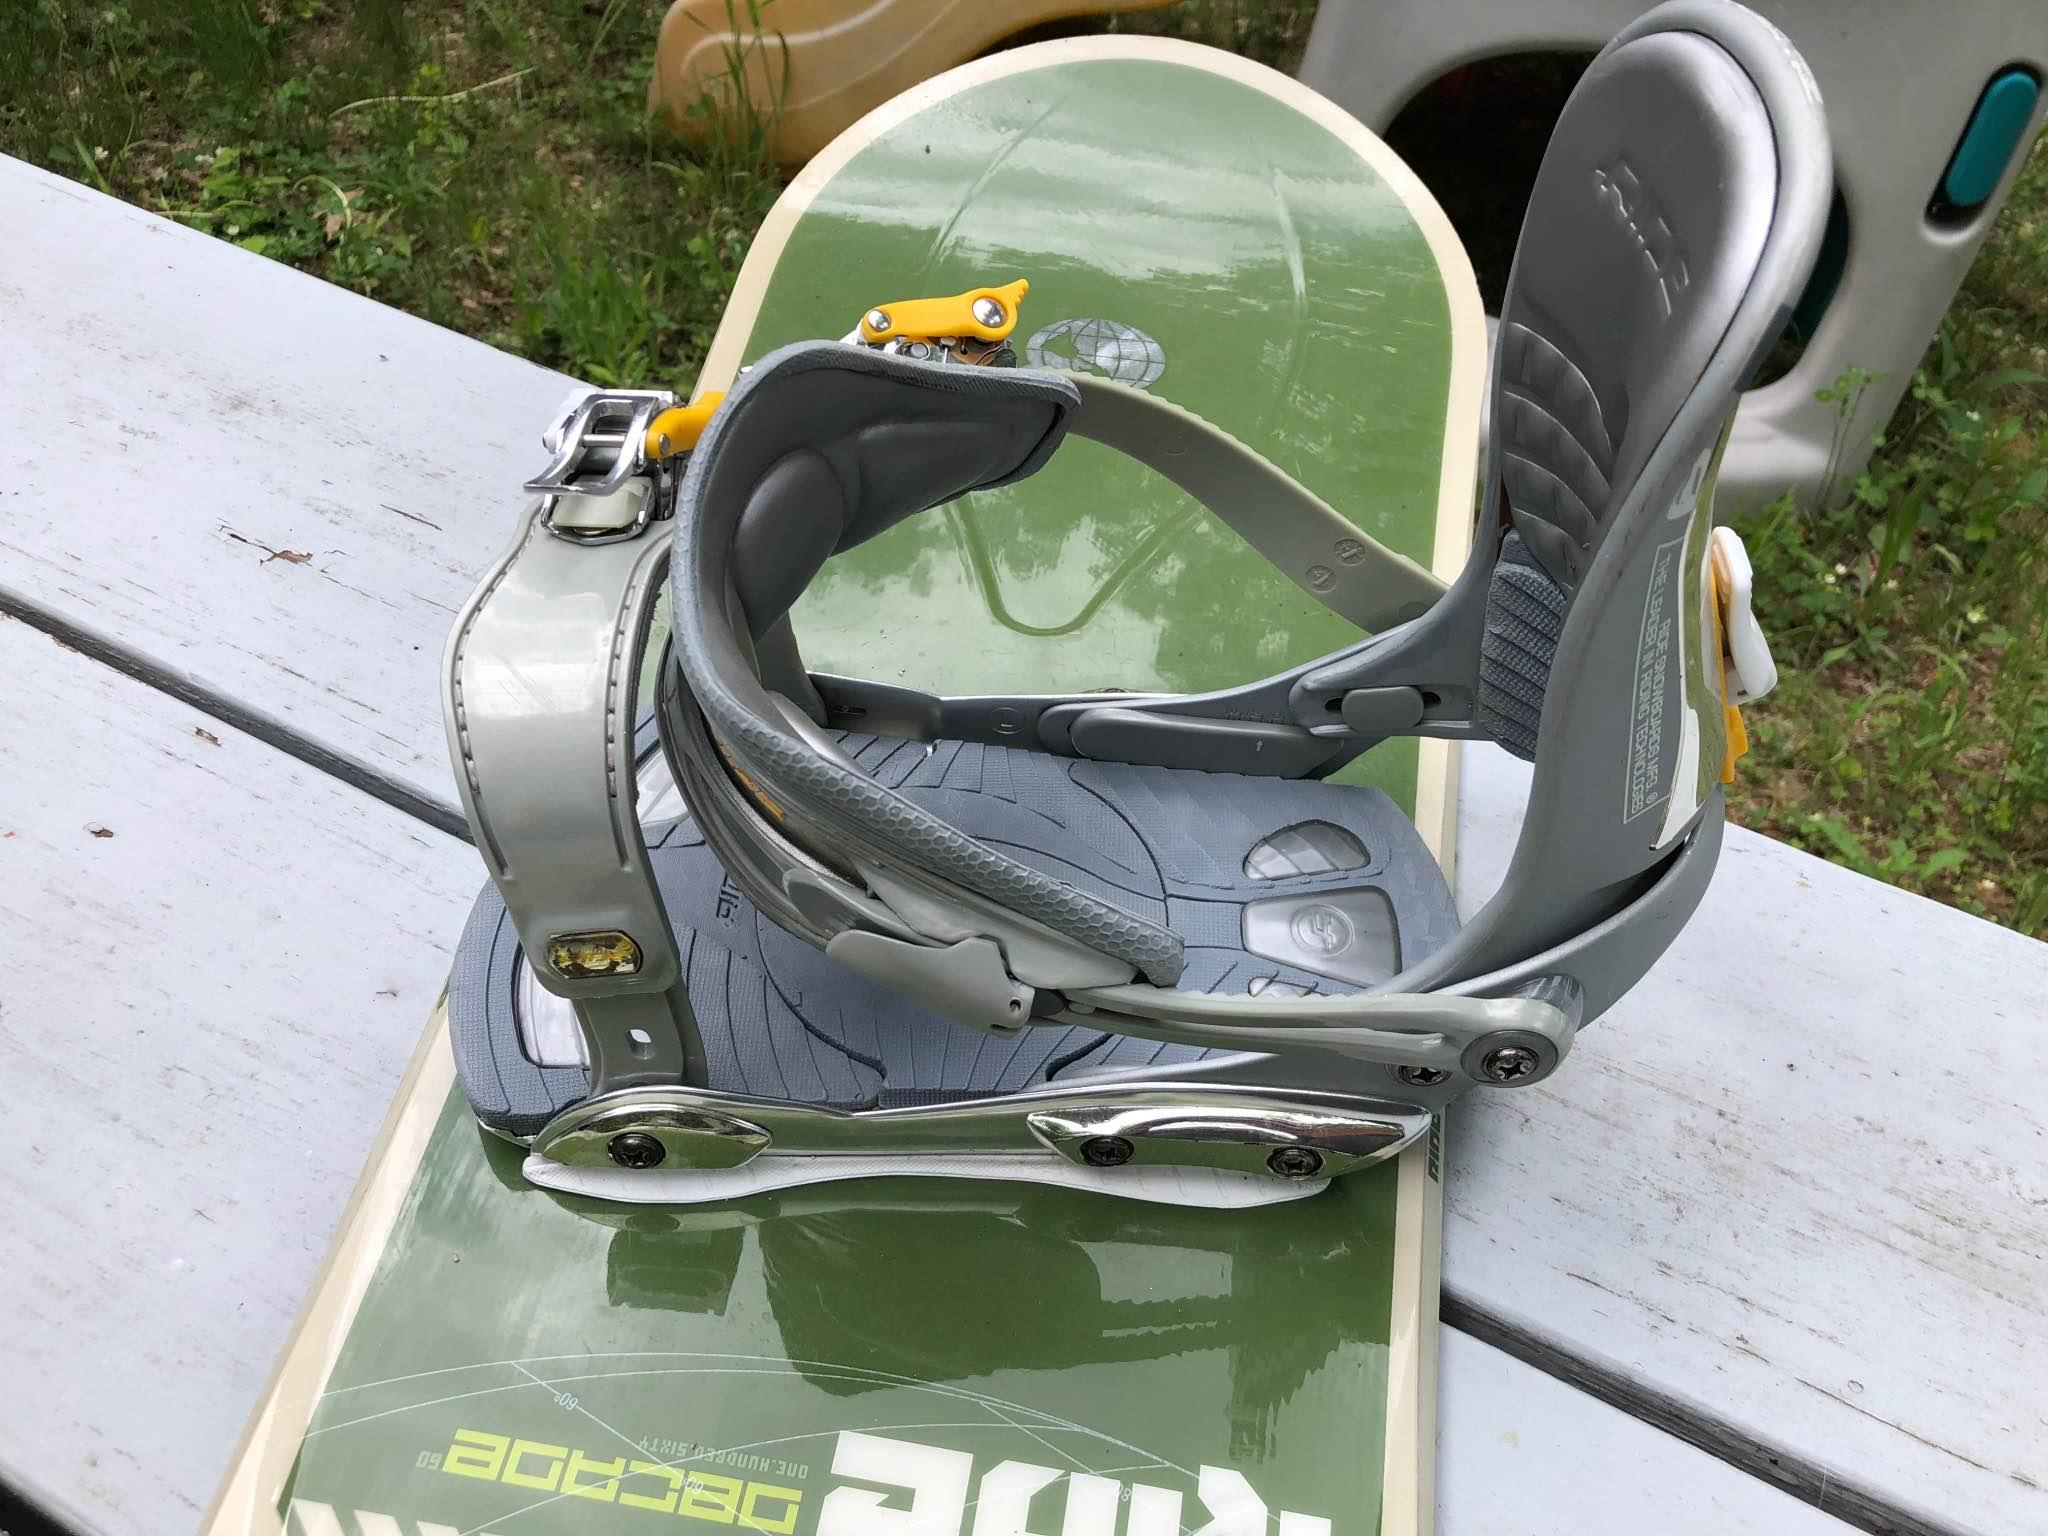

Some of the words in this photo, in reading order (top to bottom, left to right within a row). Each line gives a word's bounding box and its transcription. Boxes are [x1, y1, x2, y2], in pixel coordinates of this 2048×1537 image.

[1654, 552, 1671, 591] THE
[1644, 587, 1665, 650] LEADER
[1656, 617, 1671, 657] RIDE
[1642, 648, 1655, 670] IN
[1638, 668, 1653, 721] RIDING
[1647, 655, 1667, 759] SNOWBOARDS
[1631, 718, 1650, 814] TECHNOLOGIES
[415, 1450, 443, 1471] 60
[442, 1427, 803, 1535] DECADE
